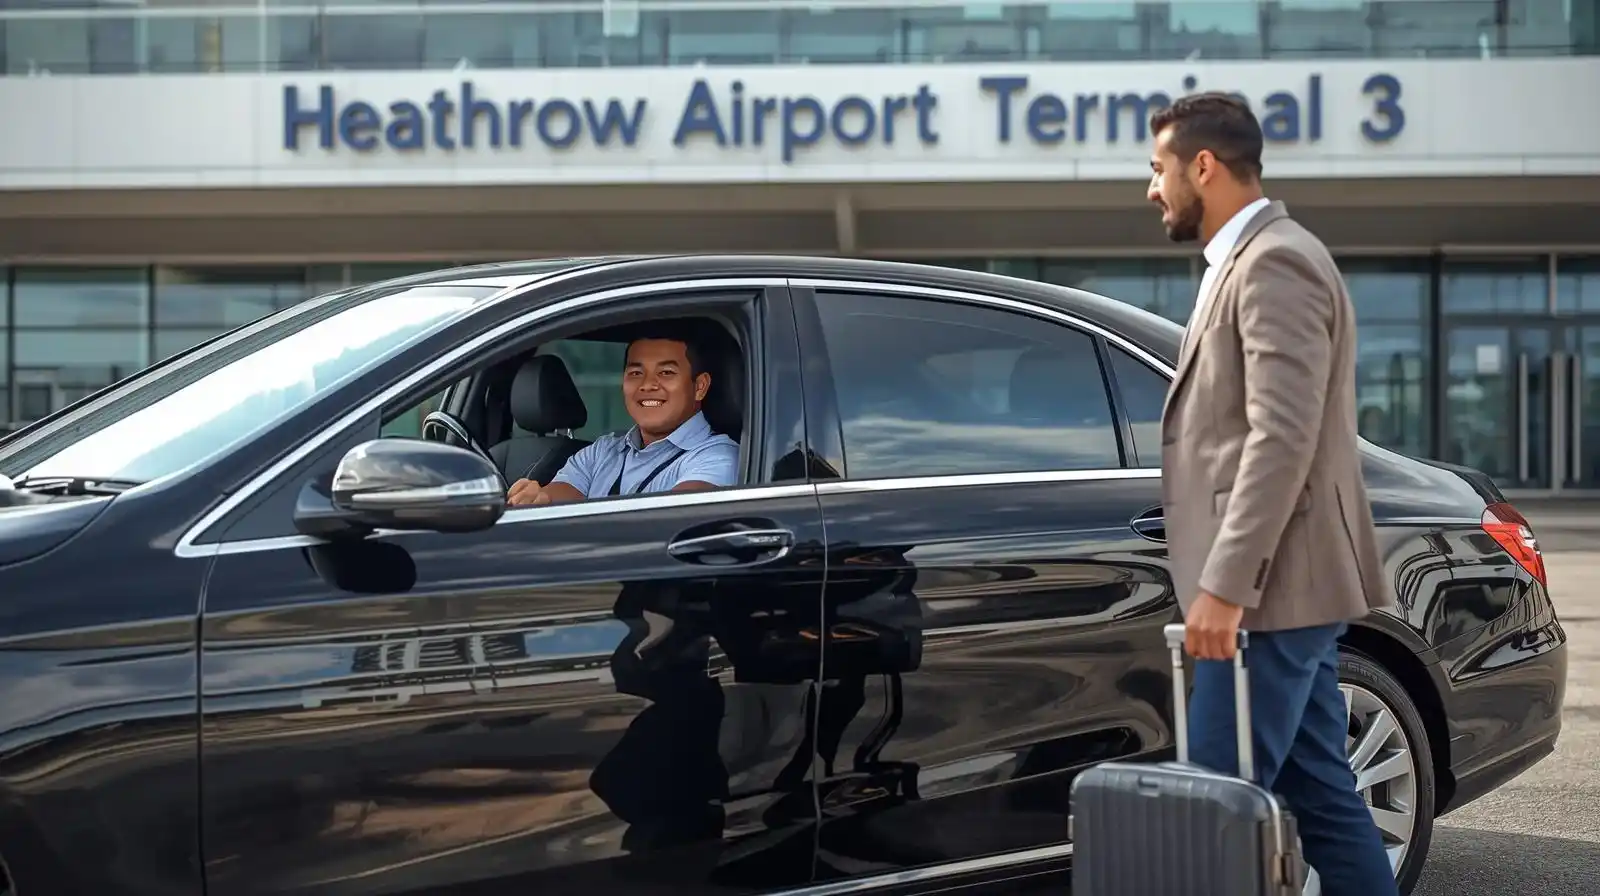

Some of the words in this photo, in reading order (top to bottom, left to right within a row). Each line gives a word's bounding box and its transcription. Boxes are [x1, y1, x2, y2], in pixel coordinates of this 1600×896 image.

[282, 81, 647, 151] Heathrow
[673, 79, 939, 163] Airport
[980, 74, 1323, 143] Termal
[1361, 73, 1406, 142] 3
